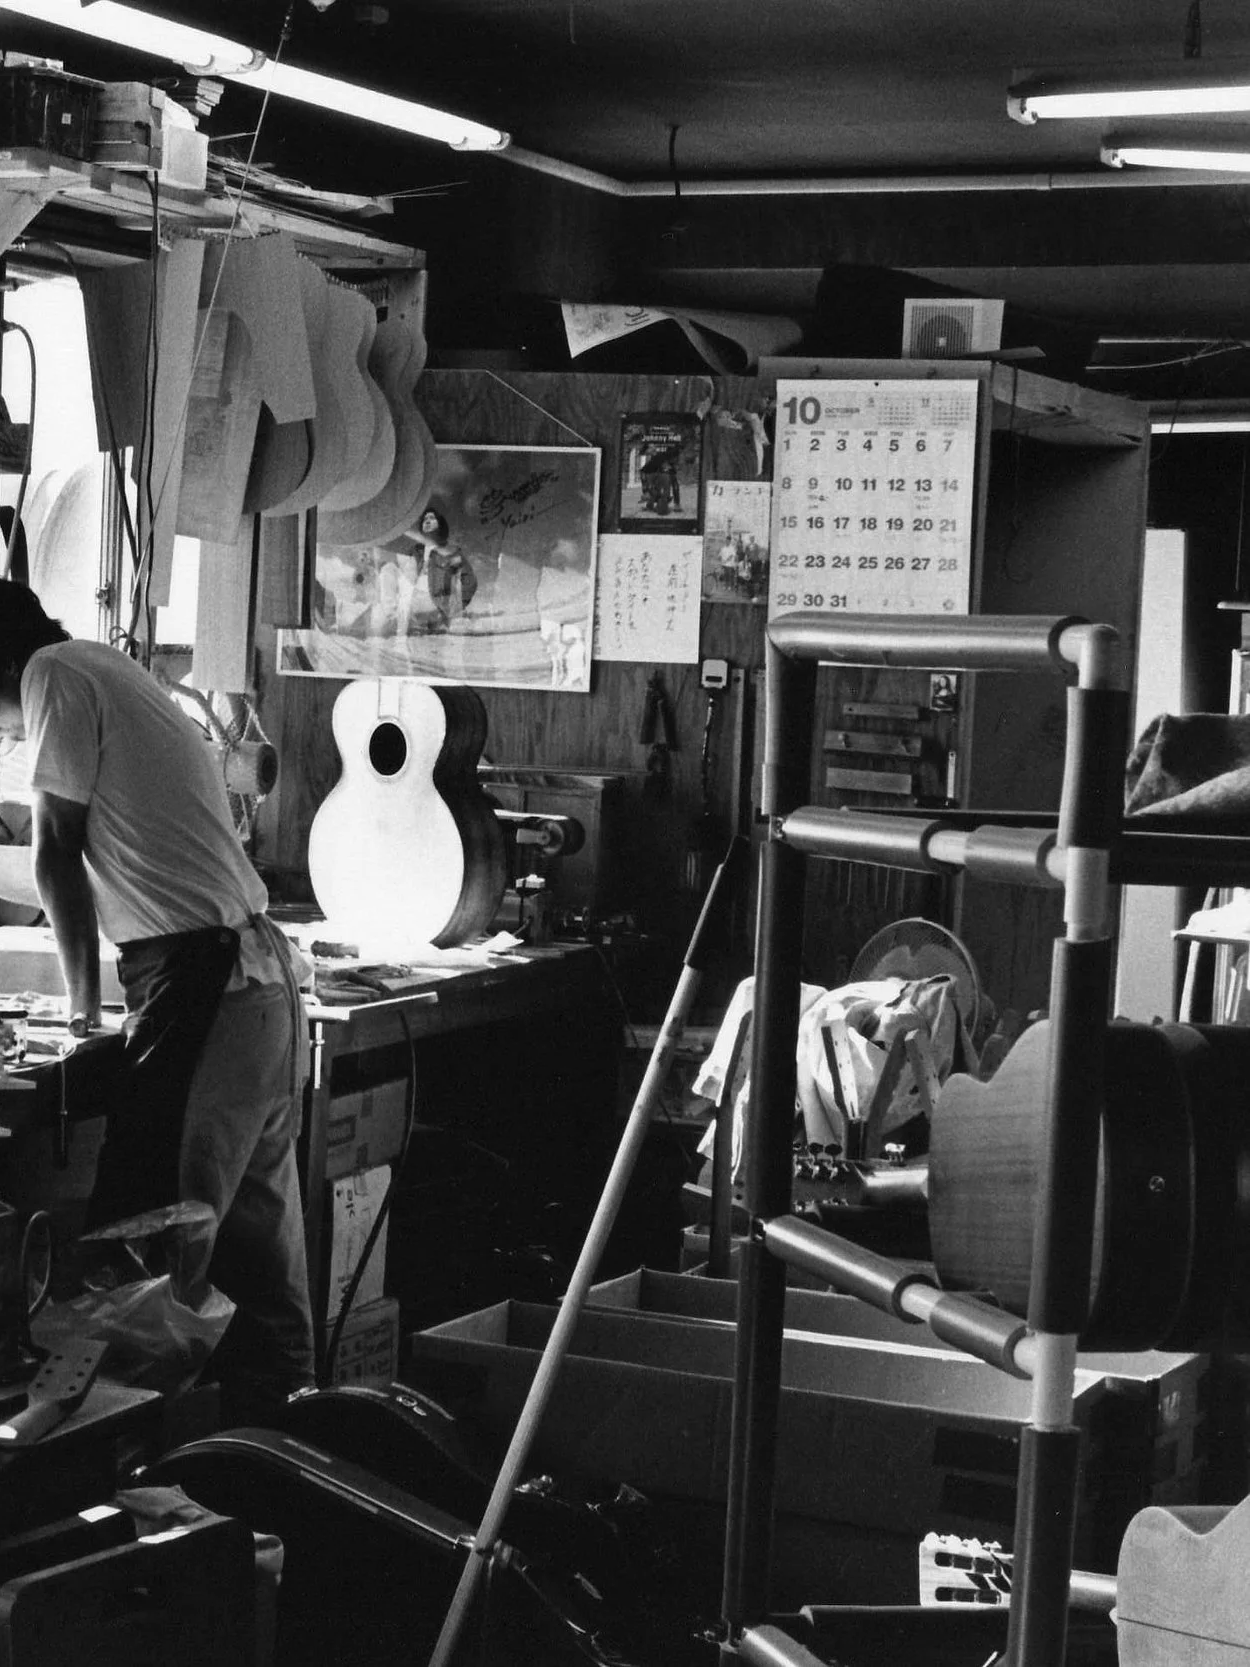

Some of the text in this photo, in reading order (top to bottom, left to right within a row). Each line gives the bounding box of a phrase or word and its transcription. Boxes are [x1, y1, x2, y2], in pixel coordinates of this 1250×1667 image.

[783, 396, 821, 425] 10
[783, 438, 952, 453] 1 2 3 4 5 6 7
[782, 477, 958, 492] 8 9 10 11 12 13 14
[781, 516, 956, 533] 15 16 17 18 19 20 21
[779, 555, 957, 571] 22 23 24 25 26 27 28
[778, 594, 796, 605] 29
[804, 594, 824, 606] 30
[830, 595, 847, 607] 31
